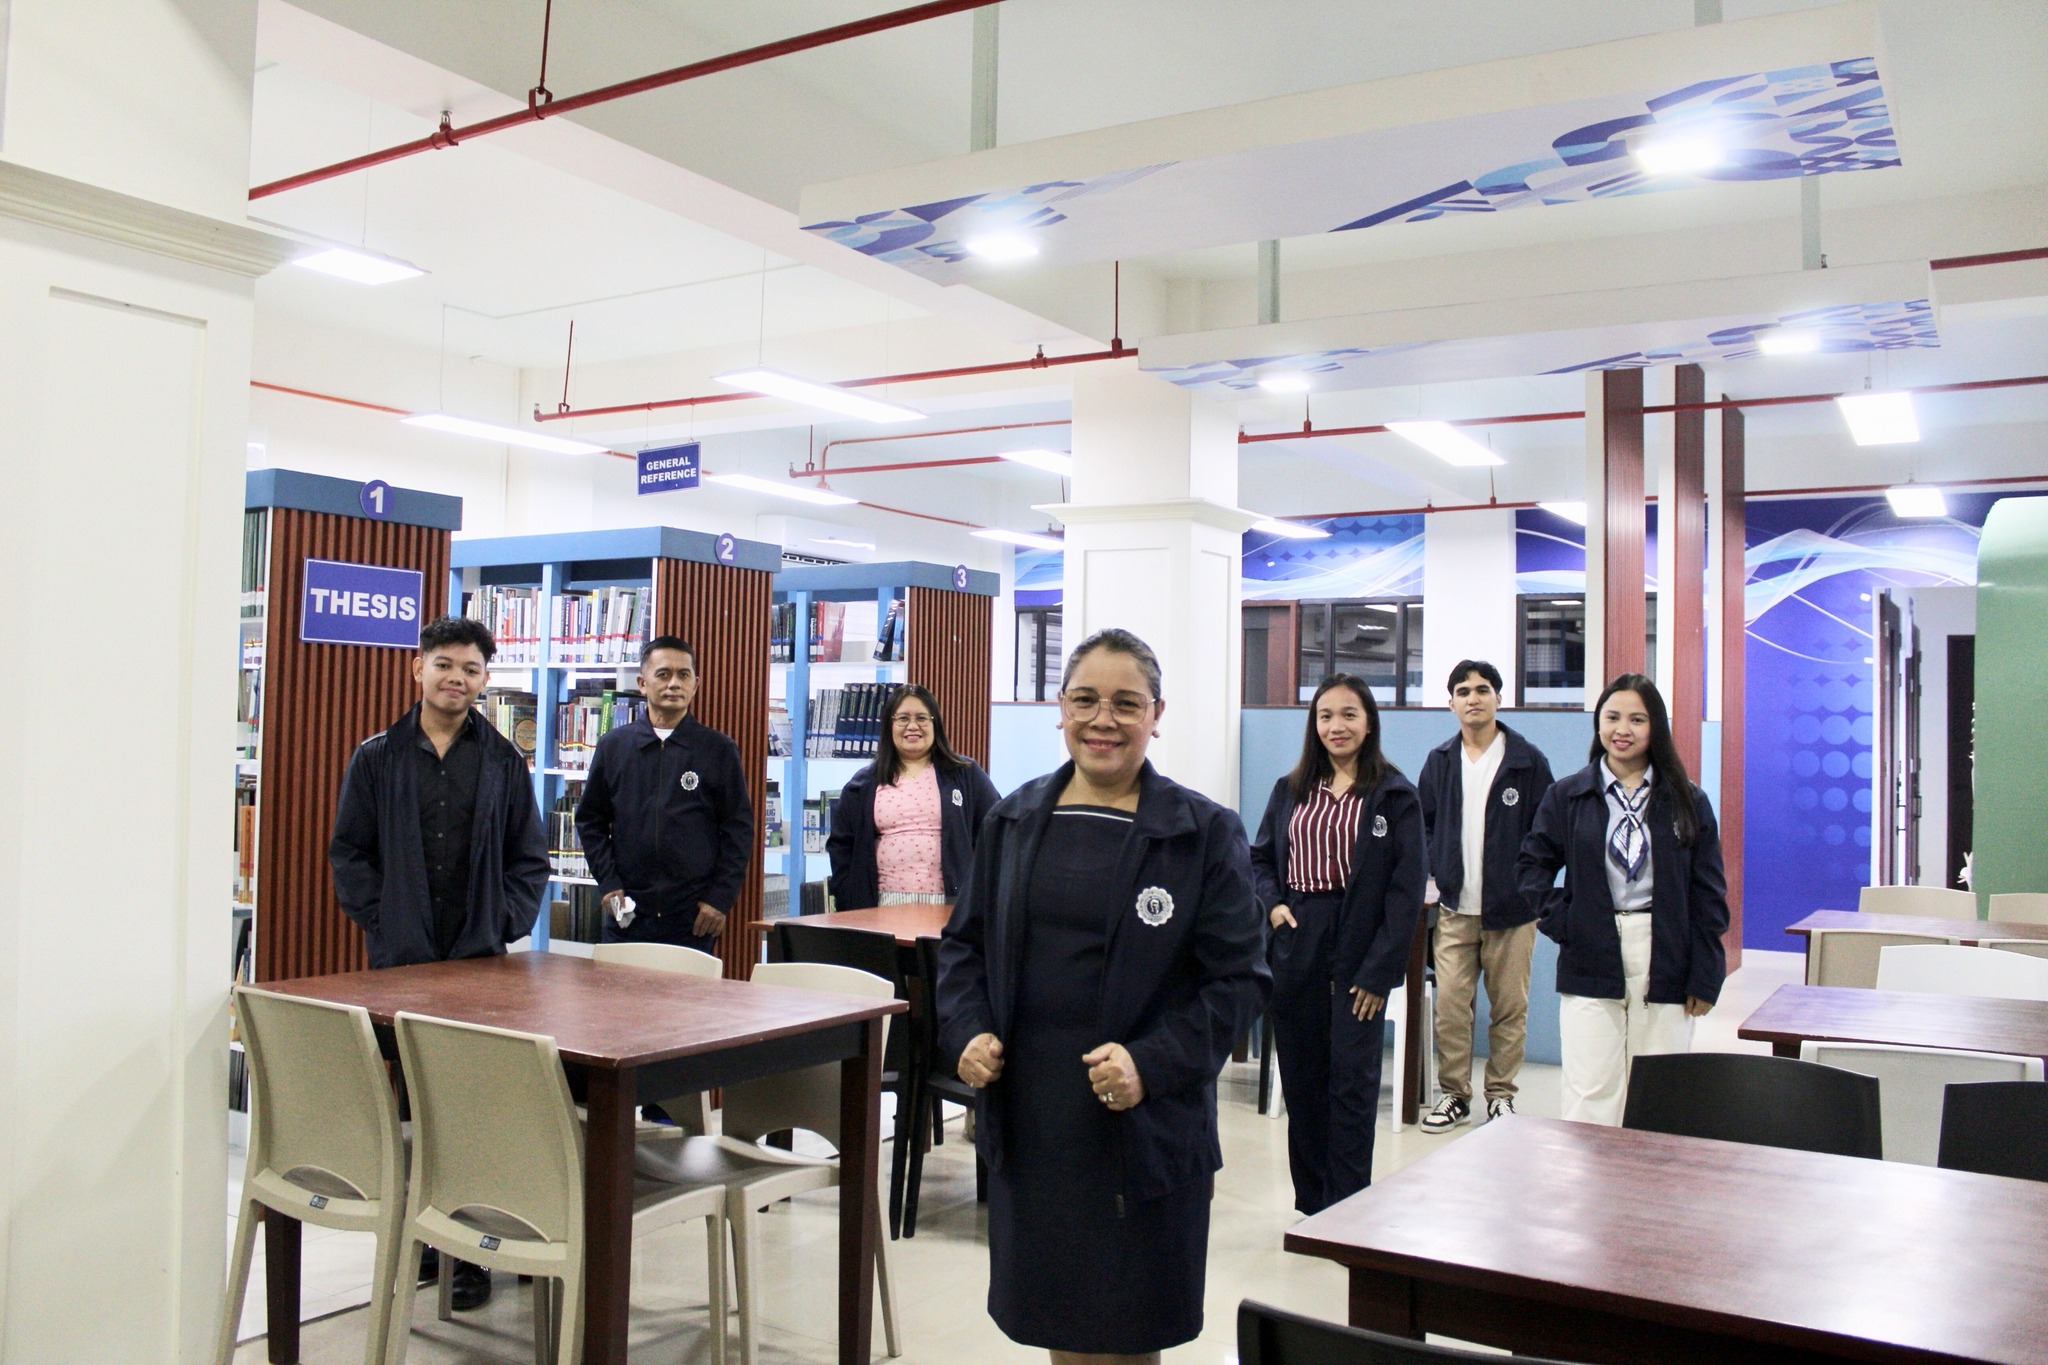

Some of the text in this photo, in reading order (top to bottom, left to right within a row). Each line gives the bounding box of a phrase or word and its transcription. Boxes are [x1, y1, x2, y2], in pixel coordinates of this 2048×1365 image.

[646, 456, 691, 471] GENERAL
[640, 467, 697, 485] REFERENCE
[369, 486, 384, 514] 1
[721, 537, 734, 560] 2
[957, 568, 967, 588] 3
[310, 588, 416, 621] THESIS
